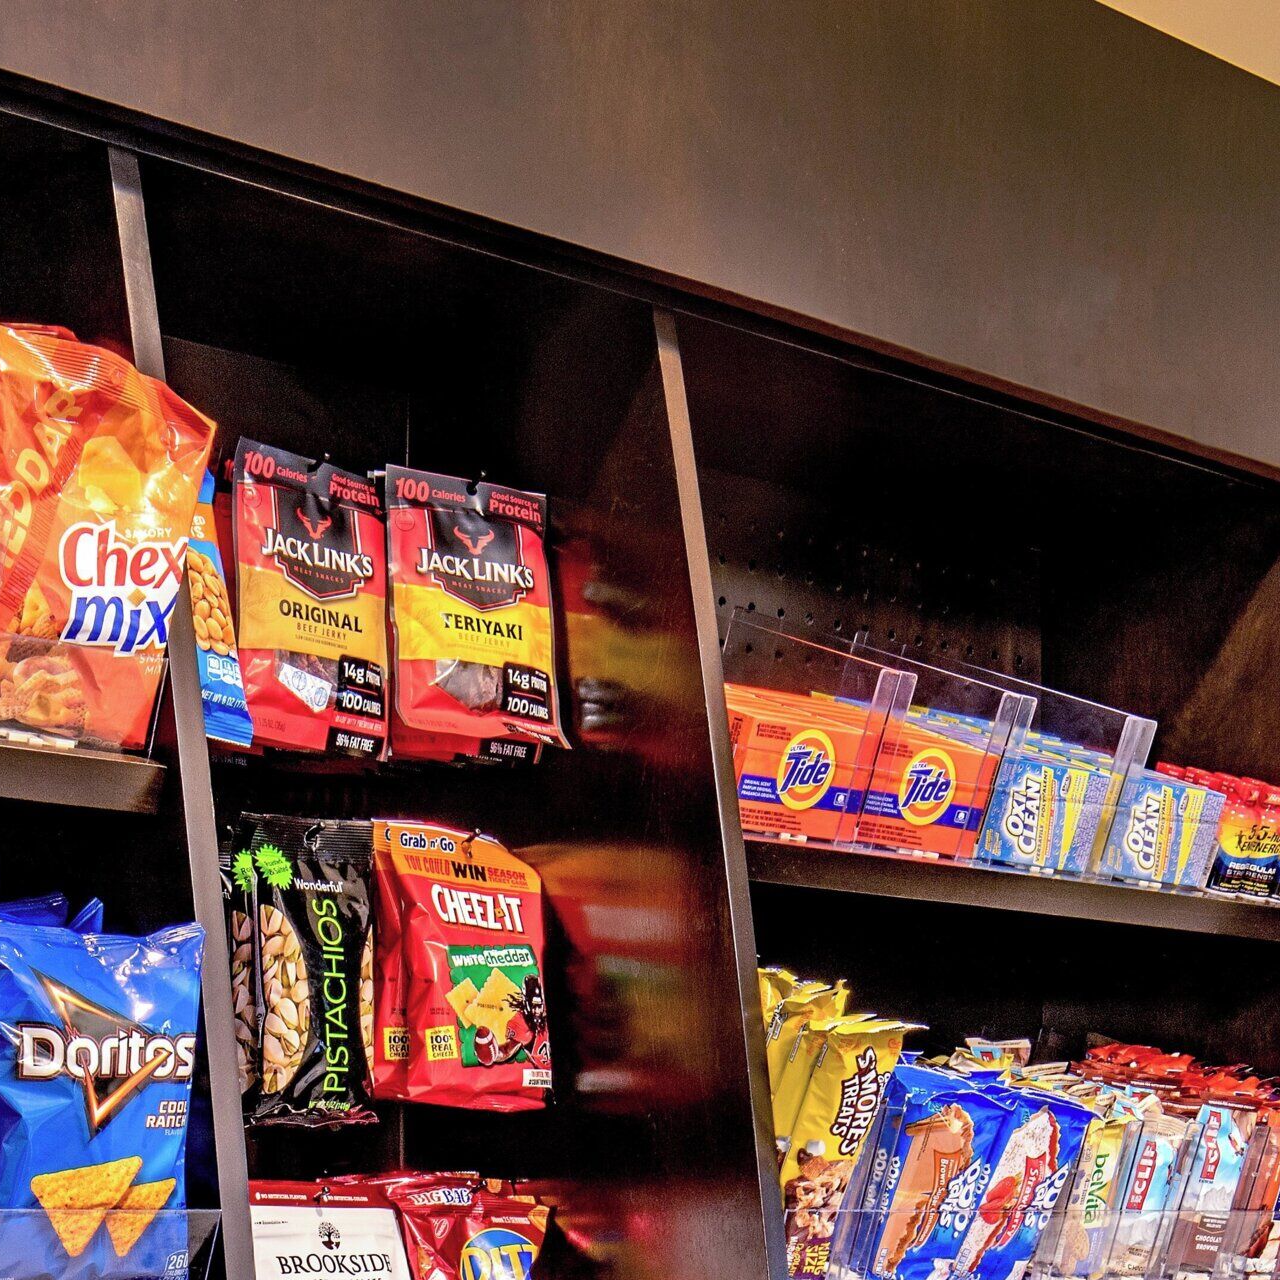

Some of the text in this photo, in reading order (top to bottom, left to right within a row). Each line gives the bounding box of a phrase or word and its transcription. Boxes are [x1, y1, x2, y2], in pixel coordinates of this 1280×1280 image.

[244, 450, 307, 483] 100 Calories
[329, 480, 380, 506] Protein
[395, 477, 466, 503] 100 Calories
[489, 500, 542, 522] Protein
[124, 527, 173, 540] SAVORY
[261, 527, 374, 578] JACK LINK'S
[63, 525, 188, 589] Chex
[416, 547, 534, 589] JACK LINK'S
[62, 592, 175, 656] mix
[278, 599, 363, 634] ORIGINAL
[296, 622, 347, 641] BEEF JERKY
[442, 612, 523, 641] TERIYAKI
[340, 691, 362, 710] 100
[778, 750, 832, 795] Tide
[899, 768, 952, 810] Tide
[1006, 788, 1027, 836] OXI
[1017, 777, 1043, 855] CLEAN
[1127, 807, 1146, 853] OXI
[1137, 796, 1160, 870] CLEAN
[294, 878, 343, 893] Wonderful
[404, 854, 526, 882] YOU COULD WIN SEASON
[312, 898, 347, 1092] PISTACHIOS
[20, 1027, 196, 1079] Doritos
[431, 1044, 454, 1052] REAL
[831, 1074, 859, 1136] TREATS
[838, 1046, 875, 1156] S'MORES
[146, 1115, 186, 1127] RANCH
[410, 1189, 471, 1205] BIG BAG
[1083, 1153, 1111, 1225] belVita
[276, 1252, 392, 1276] BROOKSIDE
